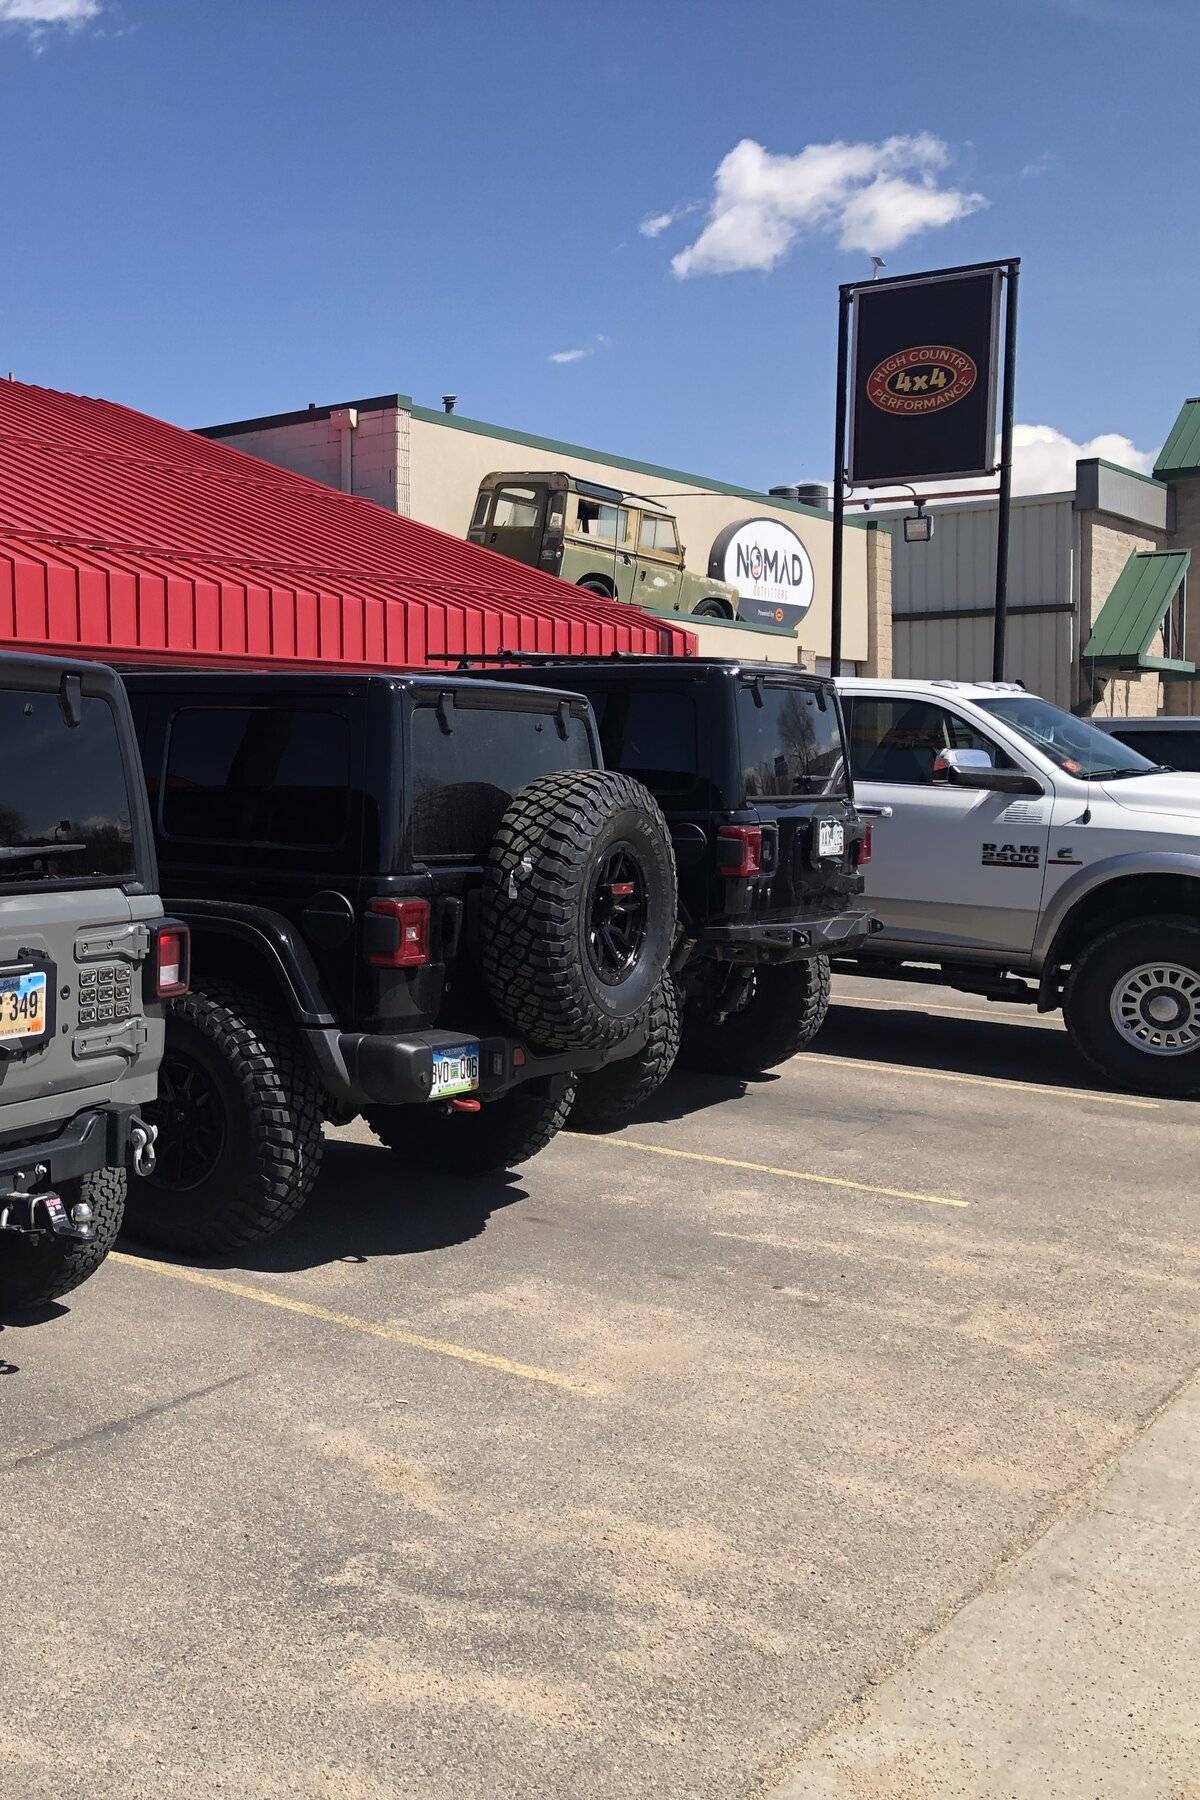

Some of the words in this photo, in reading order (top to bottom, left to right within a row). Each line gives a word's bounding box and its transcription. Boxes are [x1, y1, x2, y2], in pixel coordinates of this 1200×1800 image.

[873, 355, 907, 383] HIGH
[909, 349, 972, 373] COUNTRY
[895, 367, 948, 392] 4x4
[873, 375, 972, 411] PERFORMANCE
[736, 542, 804, 587] NOMAD
[982, 842, 1041, 854] RAM
[982, 852, 1040, 863] 2500
[9, 990, 39, 1022] 349
